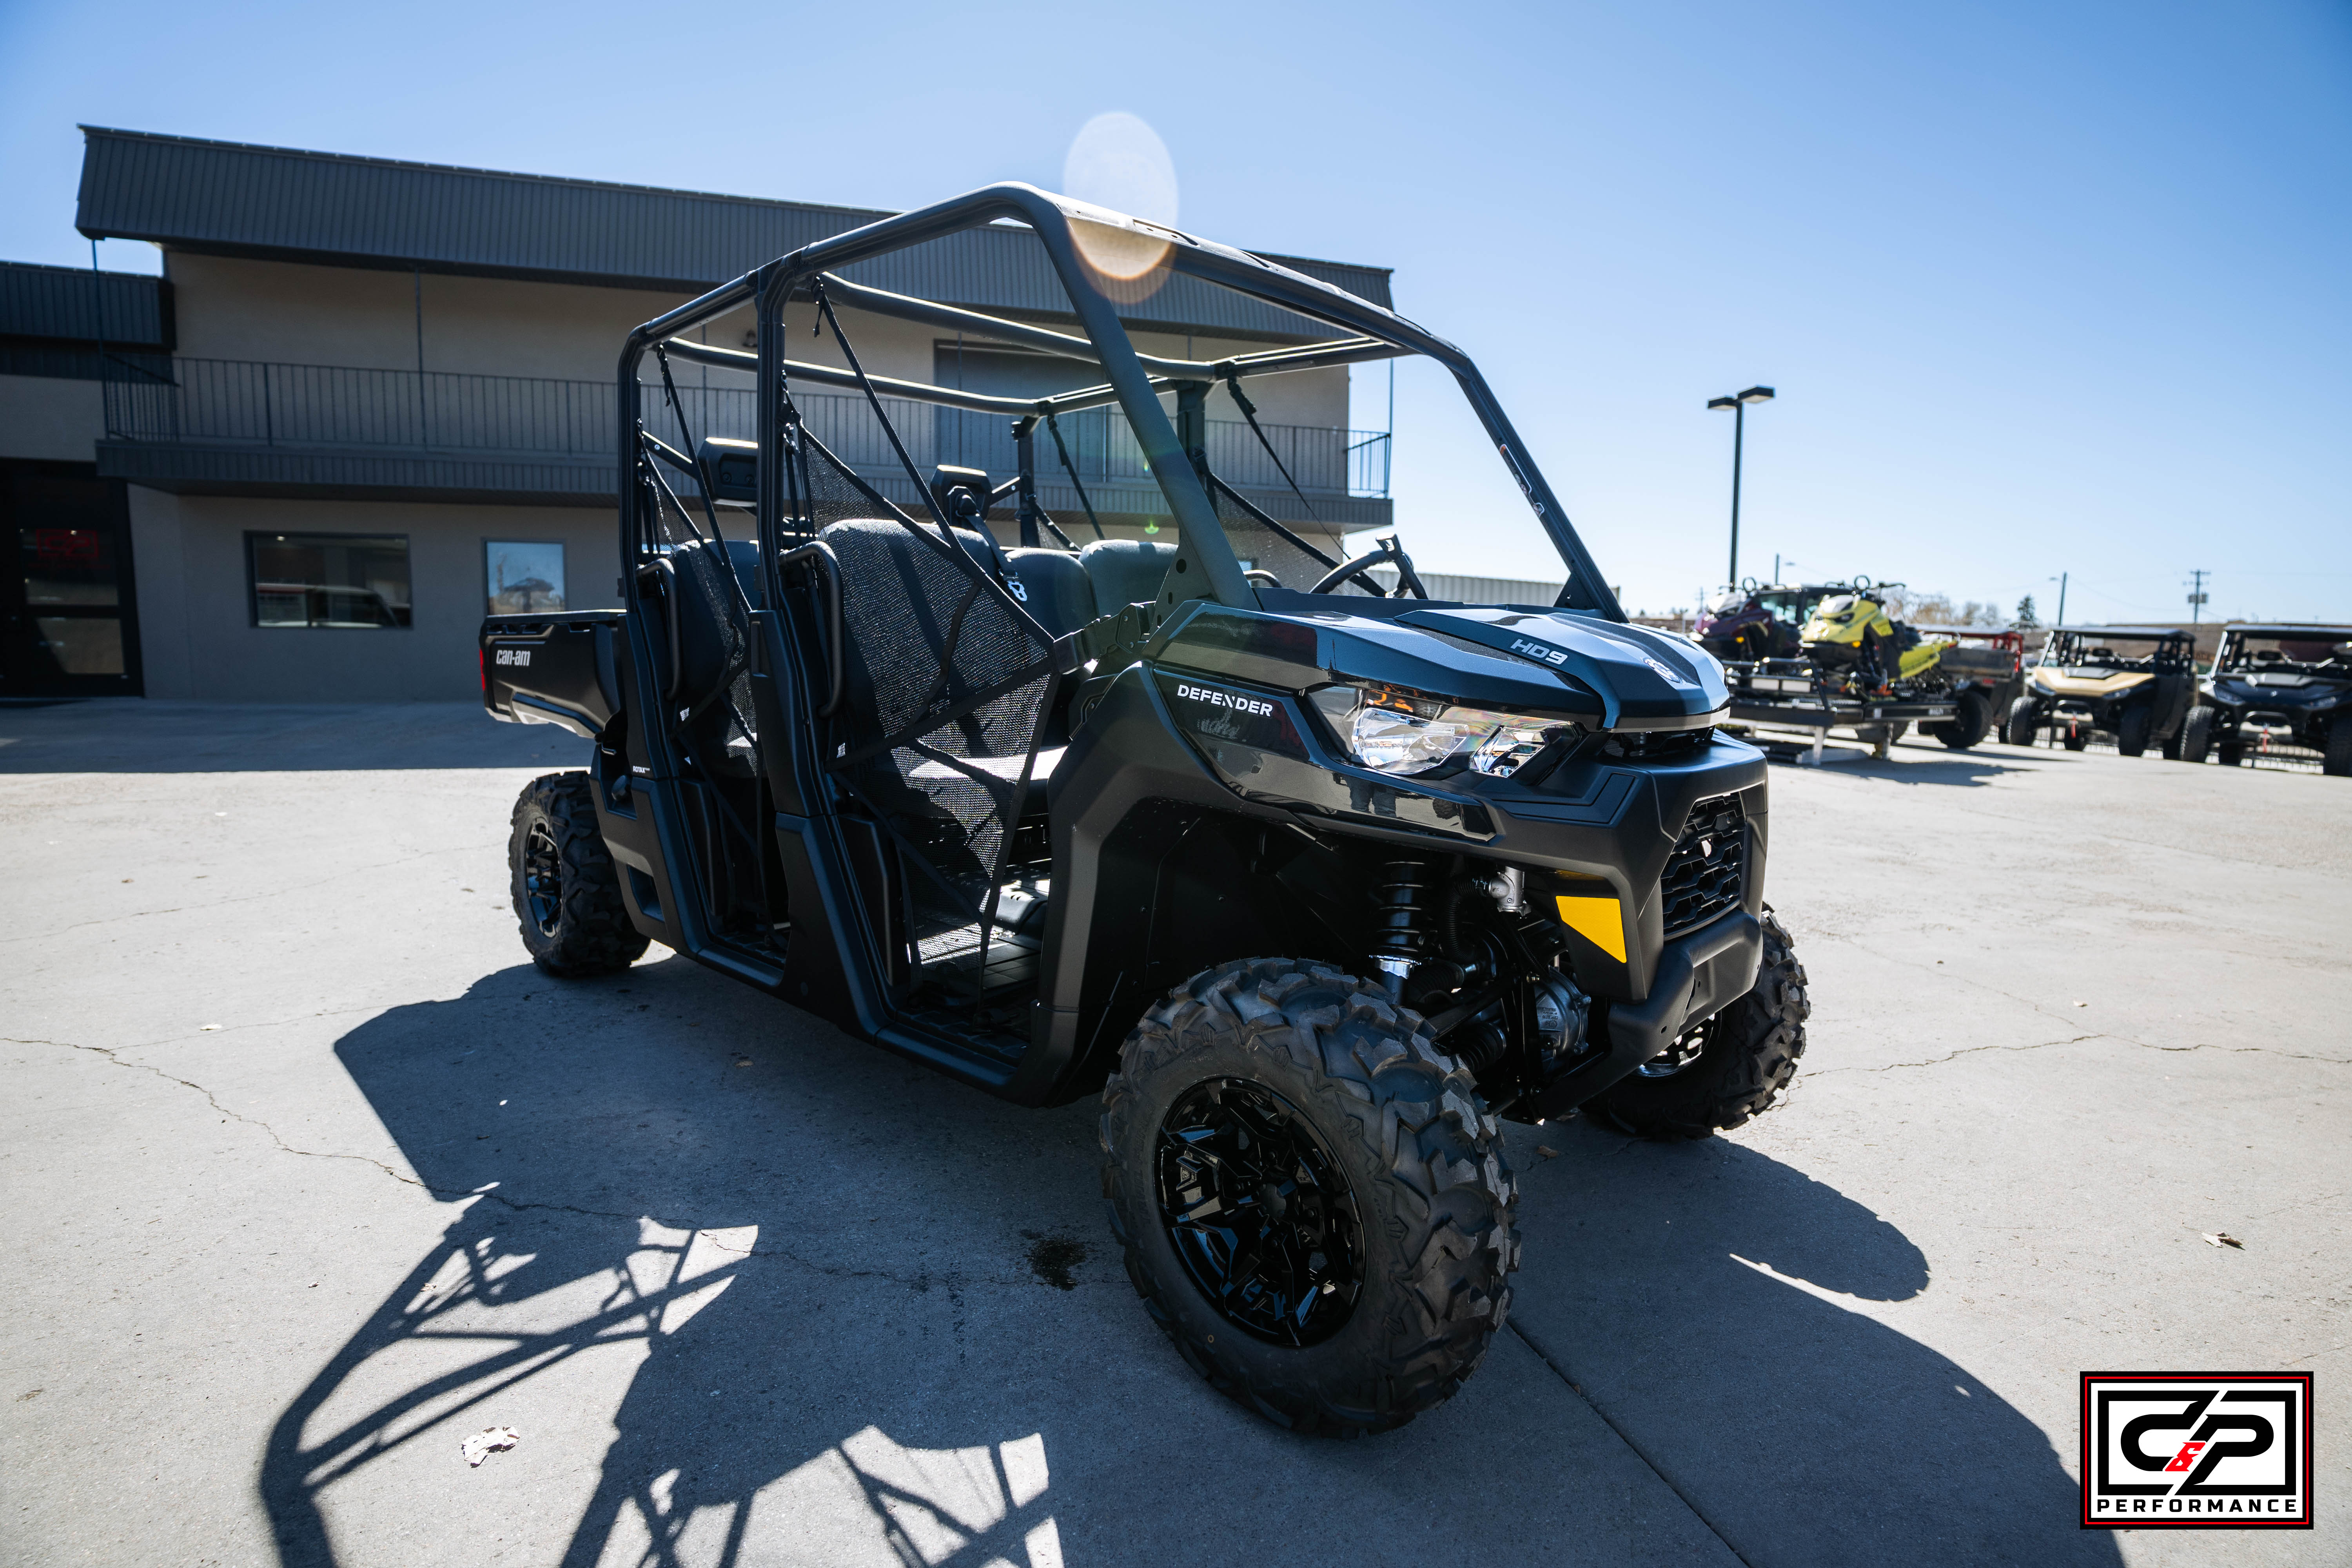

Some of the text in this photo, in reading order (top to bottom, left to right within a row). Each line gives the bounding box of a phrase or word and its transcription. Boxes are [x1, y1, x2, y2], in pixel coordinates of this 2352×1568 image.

[496, 650, 530, 666] can-am
[1510, 639, 1568, 664] HD9
[1177, 684, 1273, 717] DEFENDER
[633, 765, 646, 773] ROTAX
